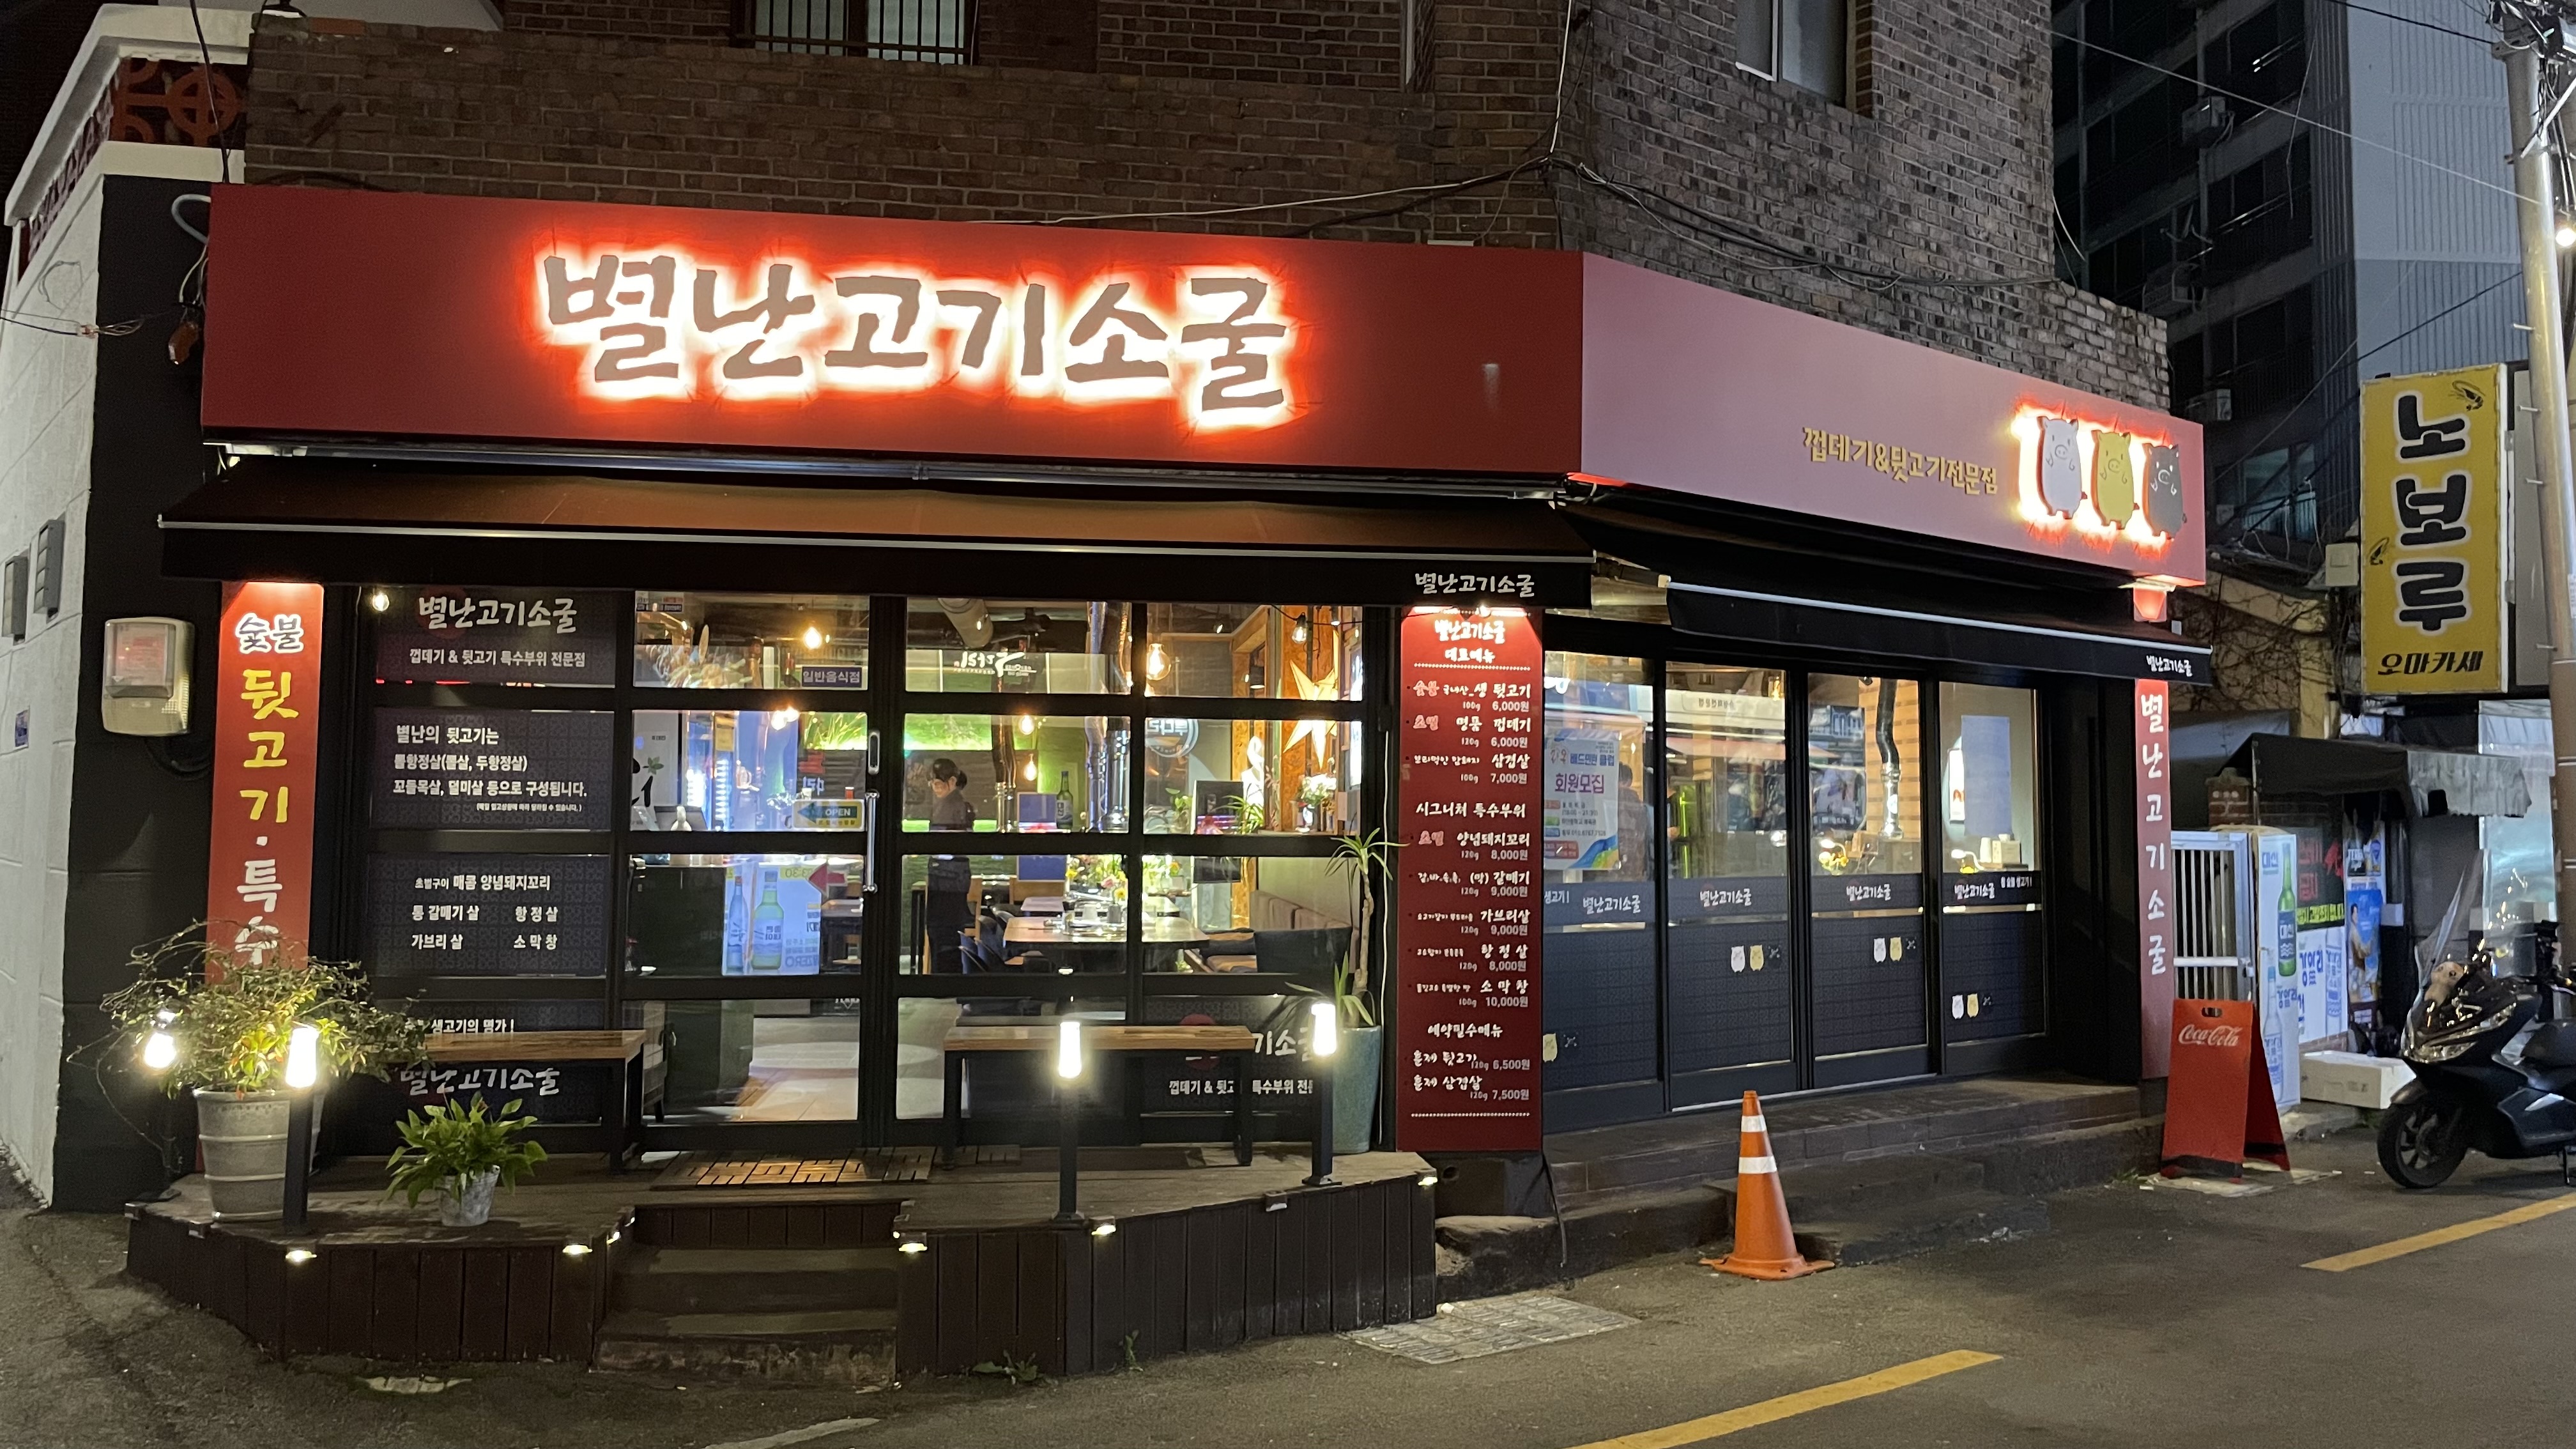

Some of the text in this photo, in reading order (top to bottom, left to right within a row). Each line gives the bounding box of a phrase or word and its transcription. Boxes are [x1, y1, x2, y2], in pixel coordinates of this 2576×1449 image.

[544, 254, 1287, 411] 별난고기소굴
[1802, 426, 1998, 494] 껍데기&뒷고기전문점
[2395, 395, 2466, 631] 노보루
[1414, 572, 1535, 597] 별난고기소굴
[419, 595, 578, 633] 별난고기소굴
[235, 612, 304, 654] 숯불
[1434, 619, 1506, 644] 별난고기소굴
[410, 648, 586, 668] 껍데기 & 뒷고기 특수부위 전문점
[2146, 655, 2193, 677] 별난고기소굴
[2377, 650, 2483, 676] 오마카세
[802, 670, 860, 684] 일반음식점
[1492, 682, 1531, 699] 뒷고기
[1462, 700, 1529, 713] 100g 6,000원
[1455, 716, 1482, 732] 명품
[1492, 717, 1531, 733] 껍데기
[396, 724, 500, 745] 별난의 뒷고기는
[1461, 736, 1528, 749] 120g 6,000원
[240, 669, 299, 823] 뒷고기
[1491, 753, 1531, 770] 삼겹살
[1460, 772, 1528, 785] 100g 7,000원
[1554, 772, 1604, 794] 회원모집
[486, 780, 523, 795] 등으로
[525, 781, 587, 797] 구성됩니다.
[825, 808, 851, 816] OPEN
[1416, 801, 1526, 818] 시그니처 특수부위
[1456, 832, 1531, 847] 양념돼지꼬리
[2140, 694, 2166, 976] 별난고기소굴
[1461, 849, 1528, 861] 120g 8,000원
[452, 874, 477, 891] 매콤
[480, 874, 551, 891] 양념돼지꼬리
[1492, 870, 1530, 885] 갈매기
[1460, 885, 1528, 898] 120g 9,000원
[1699, 888, 1752, 907] 별난고기소굴
[1846, 884, 1891, 901] 별난고기소굴
[1954, 882, 1995, 900] 별난고기소굴
[428, 905, 463, 921] 갈매기
[466, 905, 480, 921] 살
[1583, 894, 1641, 915] 별난고기소굴
[515, 906, 558, 923] 항정살
[1480, 908, 1531, 924] 가브리살
[1460, 924, 1528, 937] 120g 9,000원
[411, 933, 463, 951] 가브리 살
[513, 934, 558, 951] 소막창
[1481, 944, 1528, 959] 항정살
[1459, 961, 1527, 972] 120g 8,000원
[1480, 979, 1529, 995] 소막창
[1459, 996, 1528, 1008] 100g 10,000원
[1427, 1023, 1503, 1038] 예약필수메뉴
[2178, 1024, 2243, 1046] Coca-Cola
[1413, 1049, 1478, 1067] 훈제 뒷고기
[1471, 1059, 1530, 1071] 120g 6,500원
[1169, 1080, 1200, 1095] 껍데기
[1204, 1080, 1213, 1093] &
[1413, 1074, 1483, 1092] 훈제 삼겹살
[1469, 1089, 1529, 1101] 120g 7,500원
